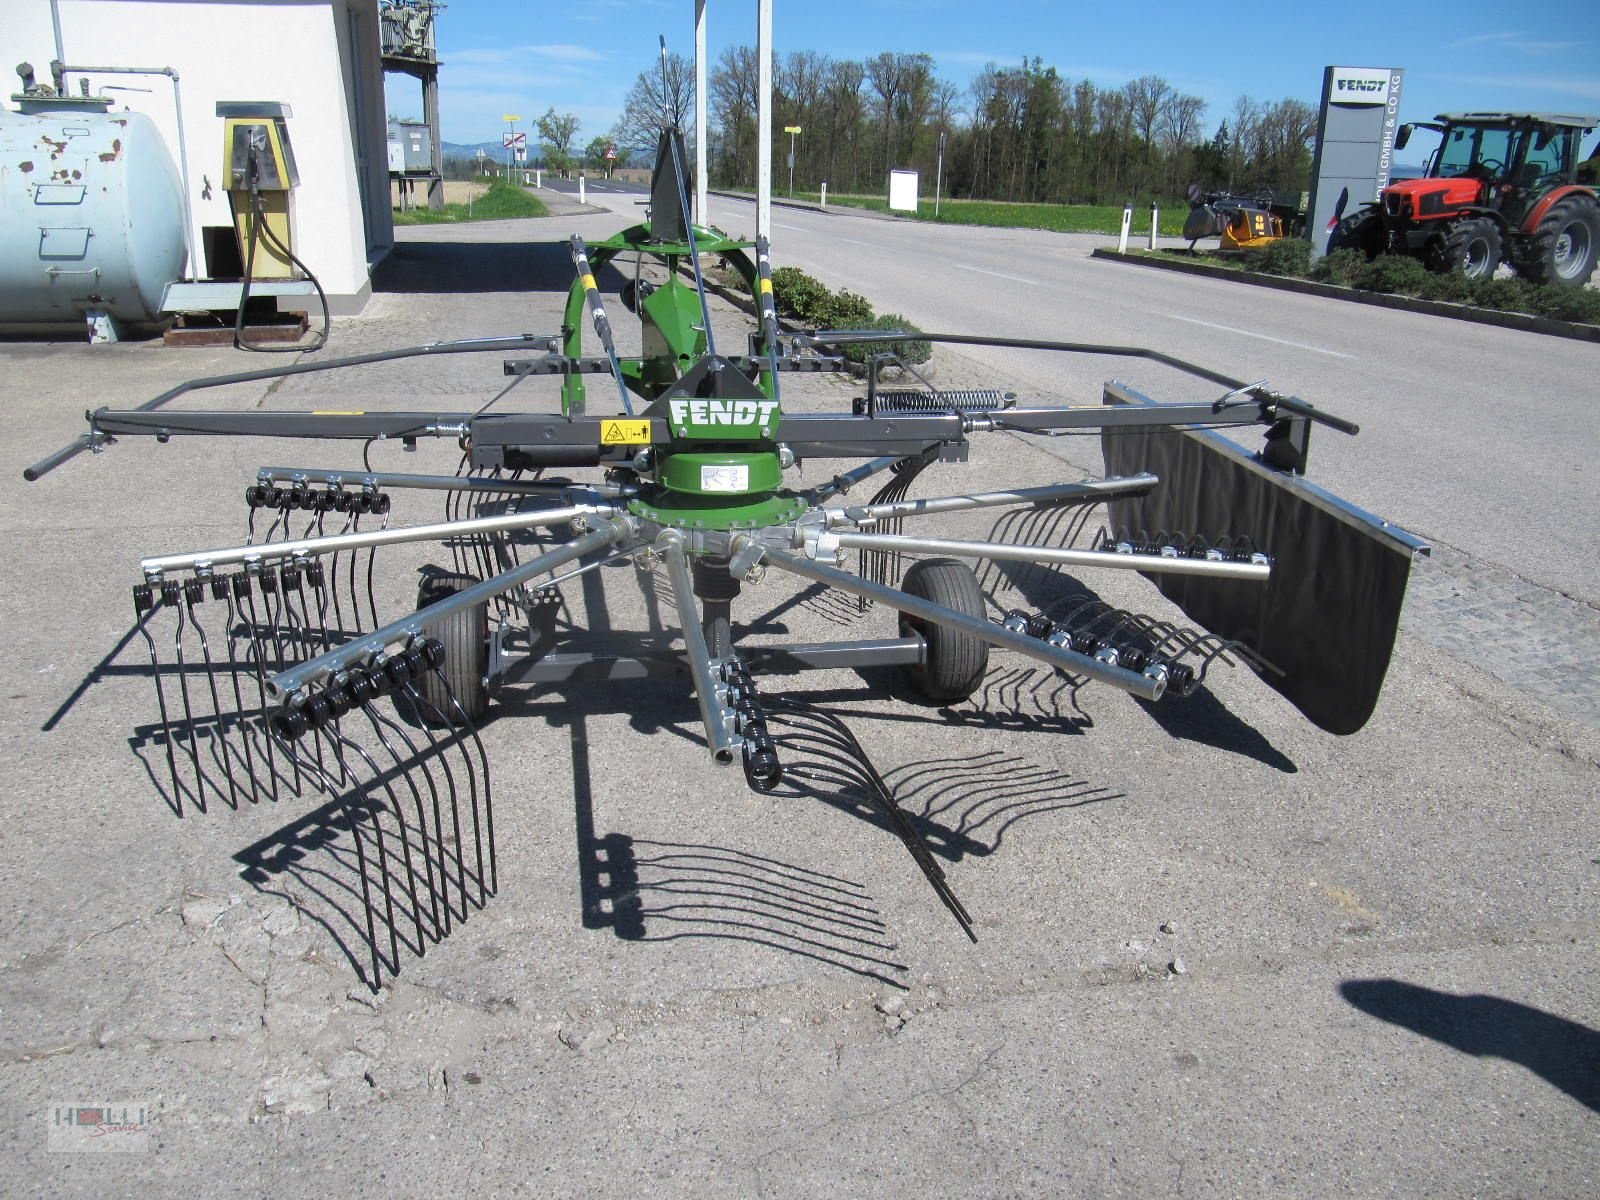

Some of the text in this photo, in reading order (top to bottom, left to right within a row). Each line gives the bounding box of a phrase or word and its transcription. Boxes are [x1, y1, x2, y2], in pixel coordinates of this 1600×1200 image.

[1337, 79, 1386, 91] FENDT
[1375, 75, 1401, 202] OLLI GMBH & CO KG
[669, 399, 779, 426] FENDT
